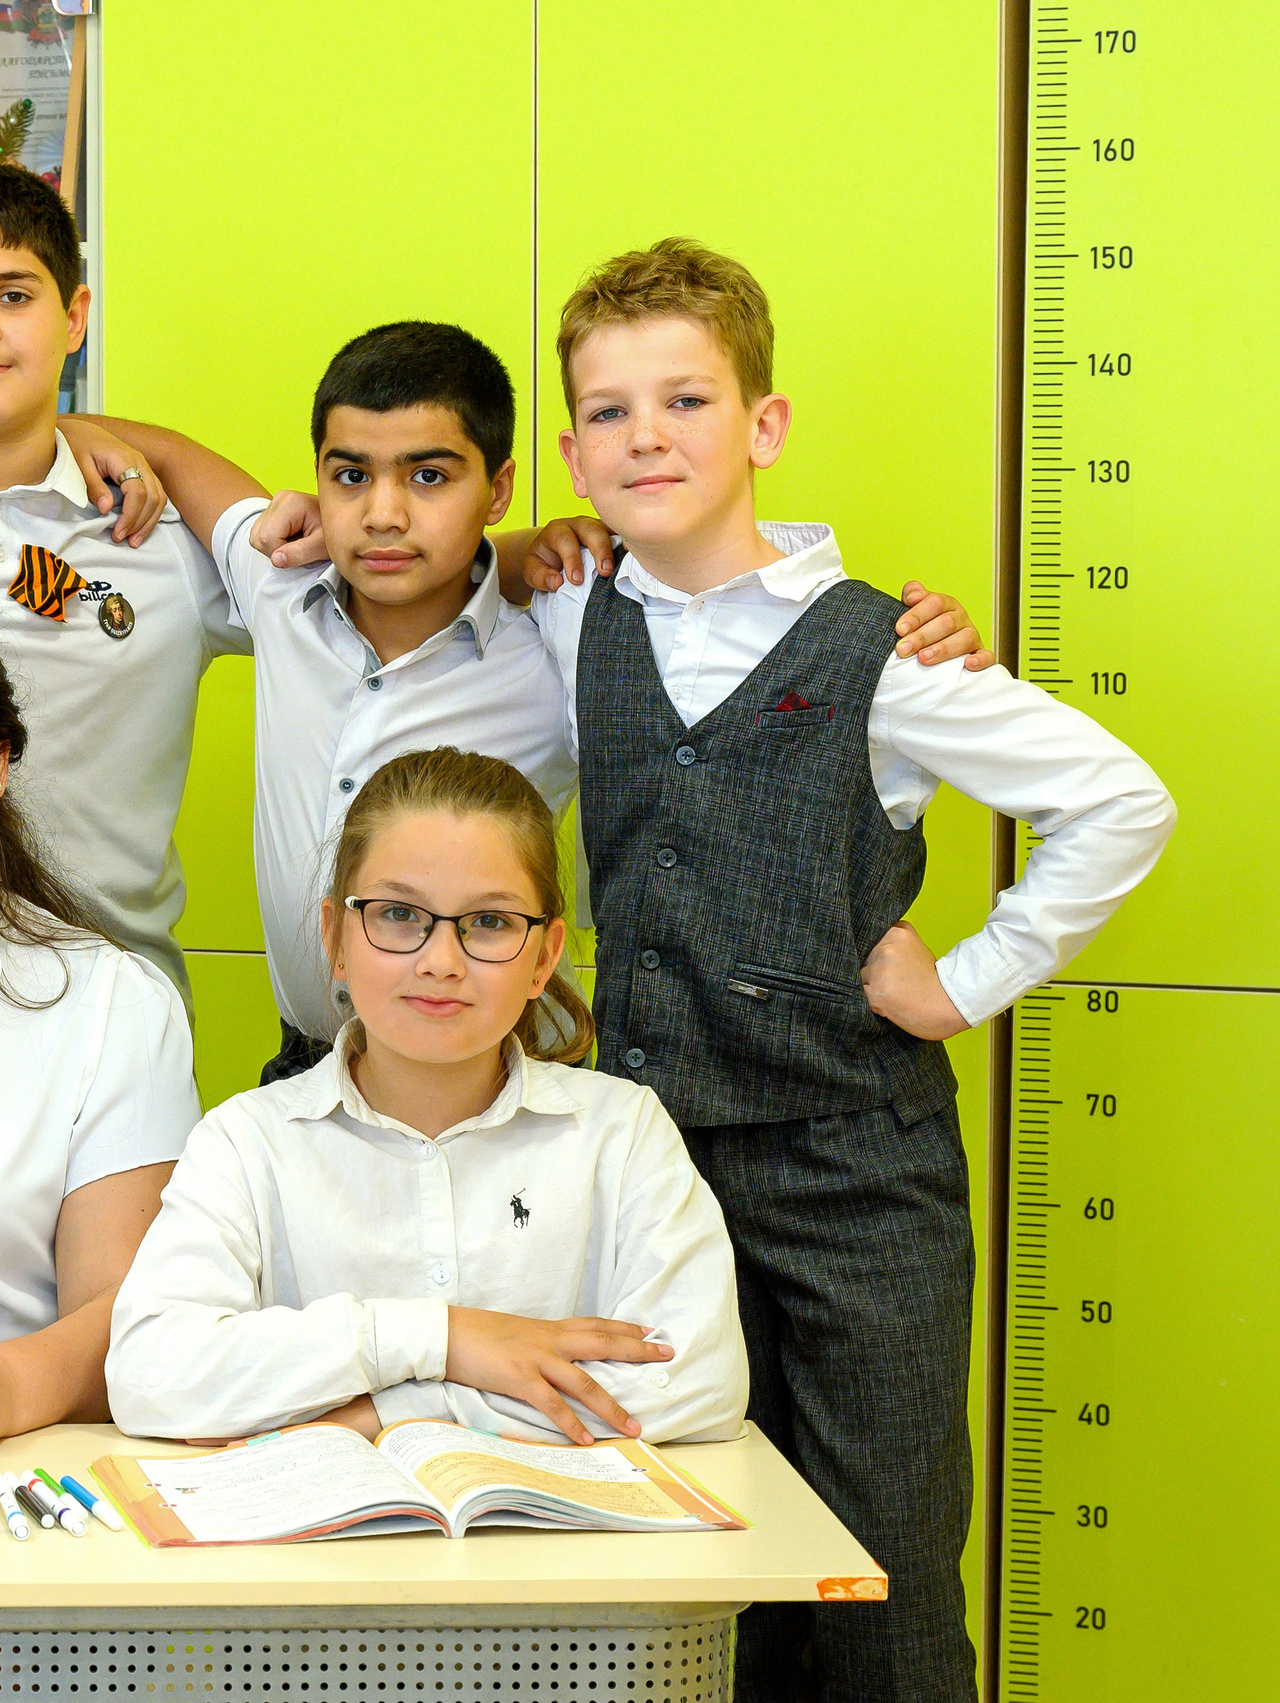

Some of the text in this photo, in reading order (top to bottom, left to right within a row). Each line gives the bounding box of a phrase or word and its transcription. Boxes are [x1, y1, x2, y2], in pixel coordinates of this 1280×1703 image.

[1095, 30, 1137, 53] 170
[1093, 138, 1135, 161] 160
[1091, 246, 1132, 269] 150
[1089, 353, 1131, 376] 140
[1088, 460, 1129, 483] 130
[1087, 566, 1128, 589] 120
[1091, 672, 1127, 695] 110
[1087, 990, 1119, 1013] 80
[1086, 1094, 1117, 1117] 70
[1084, 1197, 1115, 1220] 60
[1081, 1300, 1112, 1323] 50
[1078, 1403, 1110, 1426] 40
[1077, 1505, 1108, 1528] 30
[1075, 1607, 1106, 1630] 20
